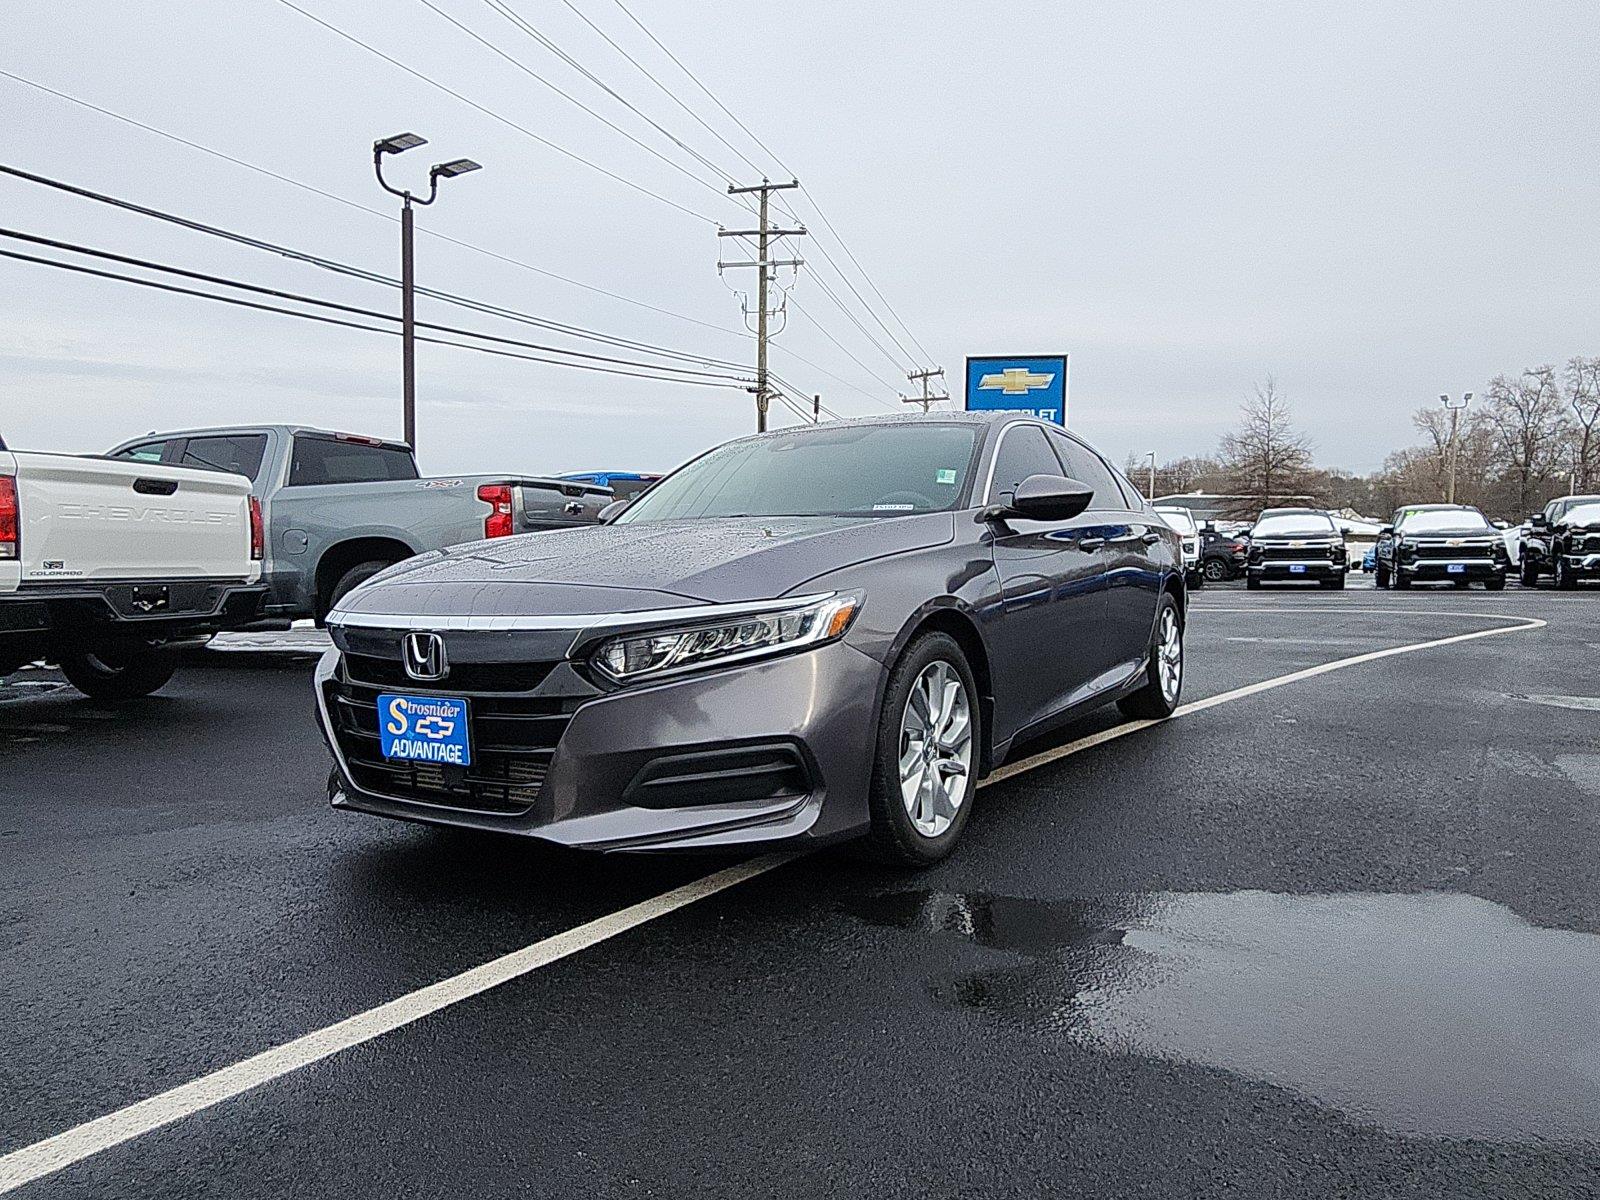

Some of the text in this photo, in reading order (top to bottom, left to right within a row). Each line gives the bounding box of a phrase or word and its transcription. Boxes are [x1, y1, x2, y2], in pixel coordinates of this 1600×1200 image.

[58, 503, 237, 525] CHEVROLET
[387, 698, 461, 735] Strosnider
[390, 738, 463, 763] ADVANTAGE
